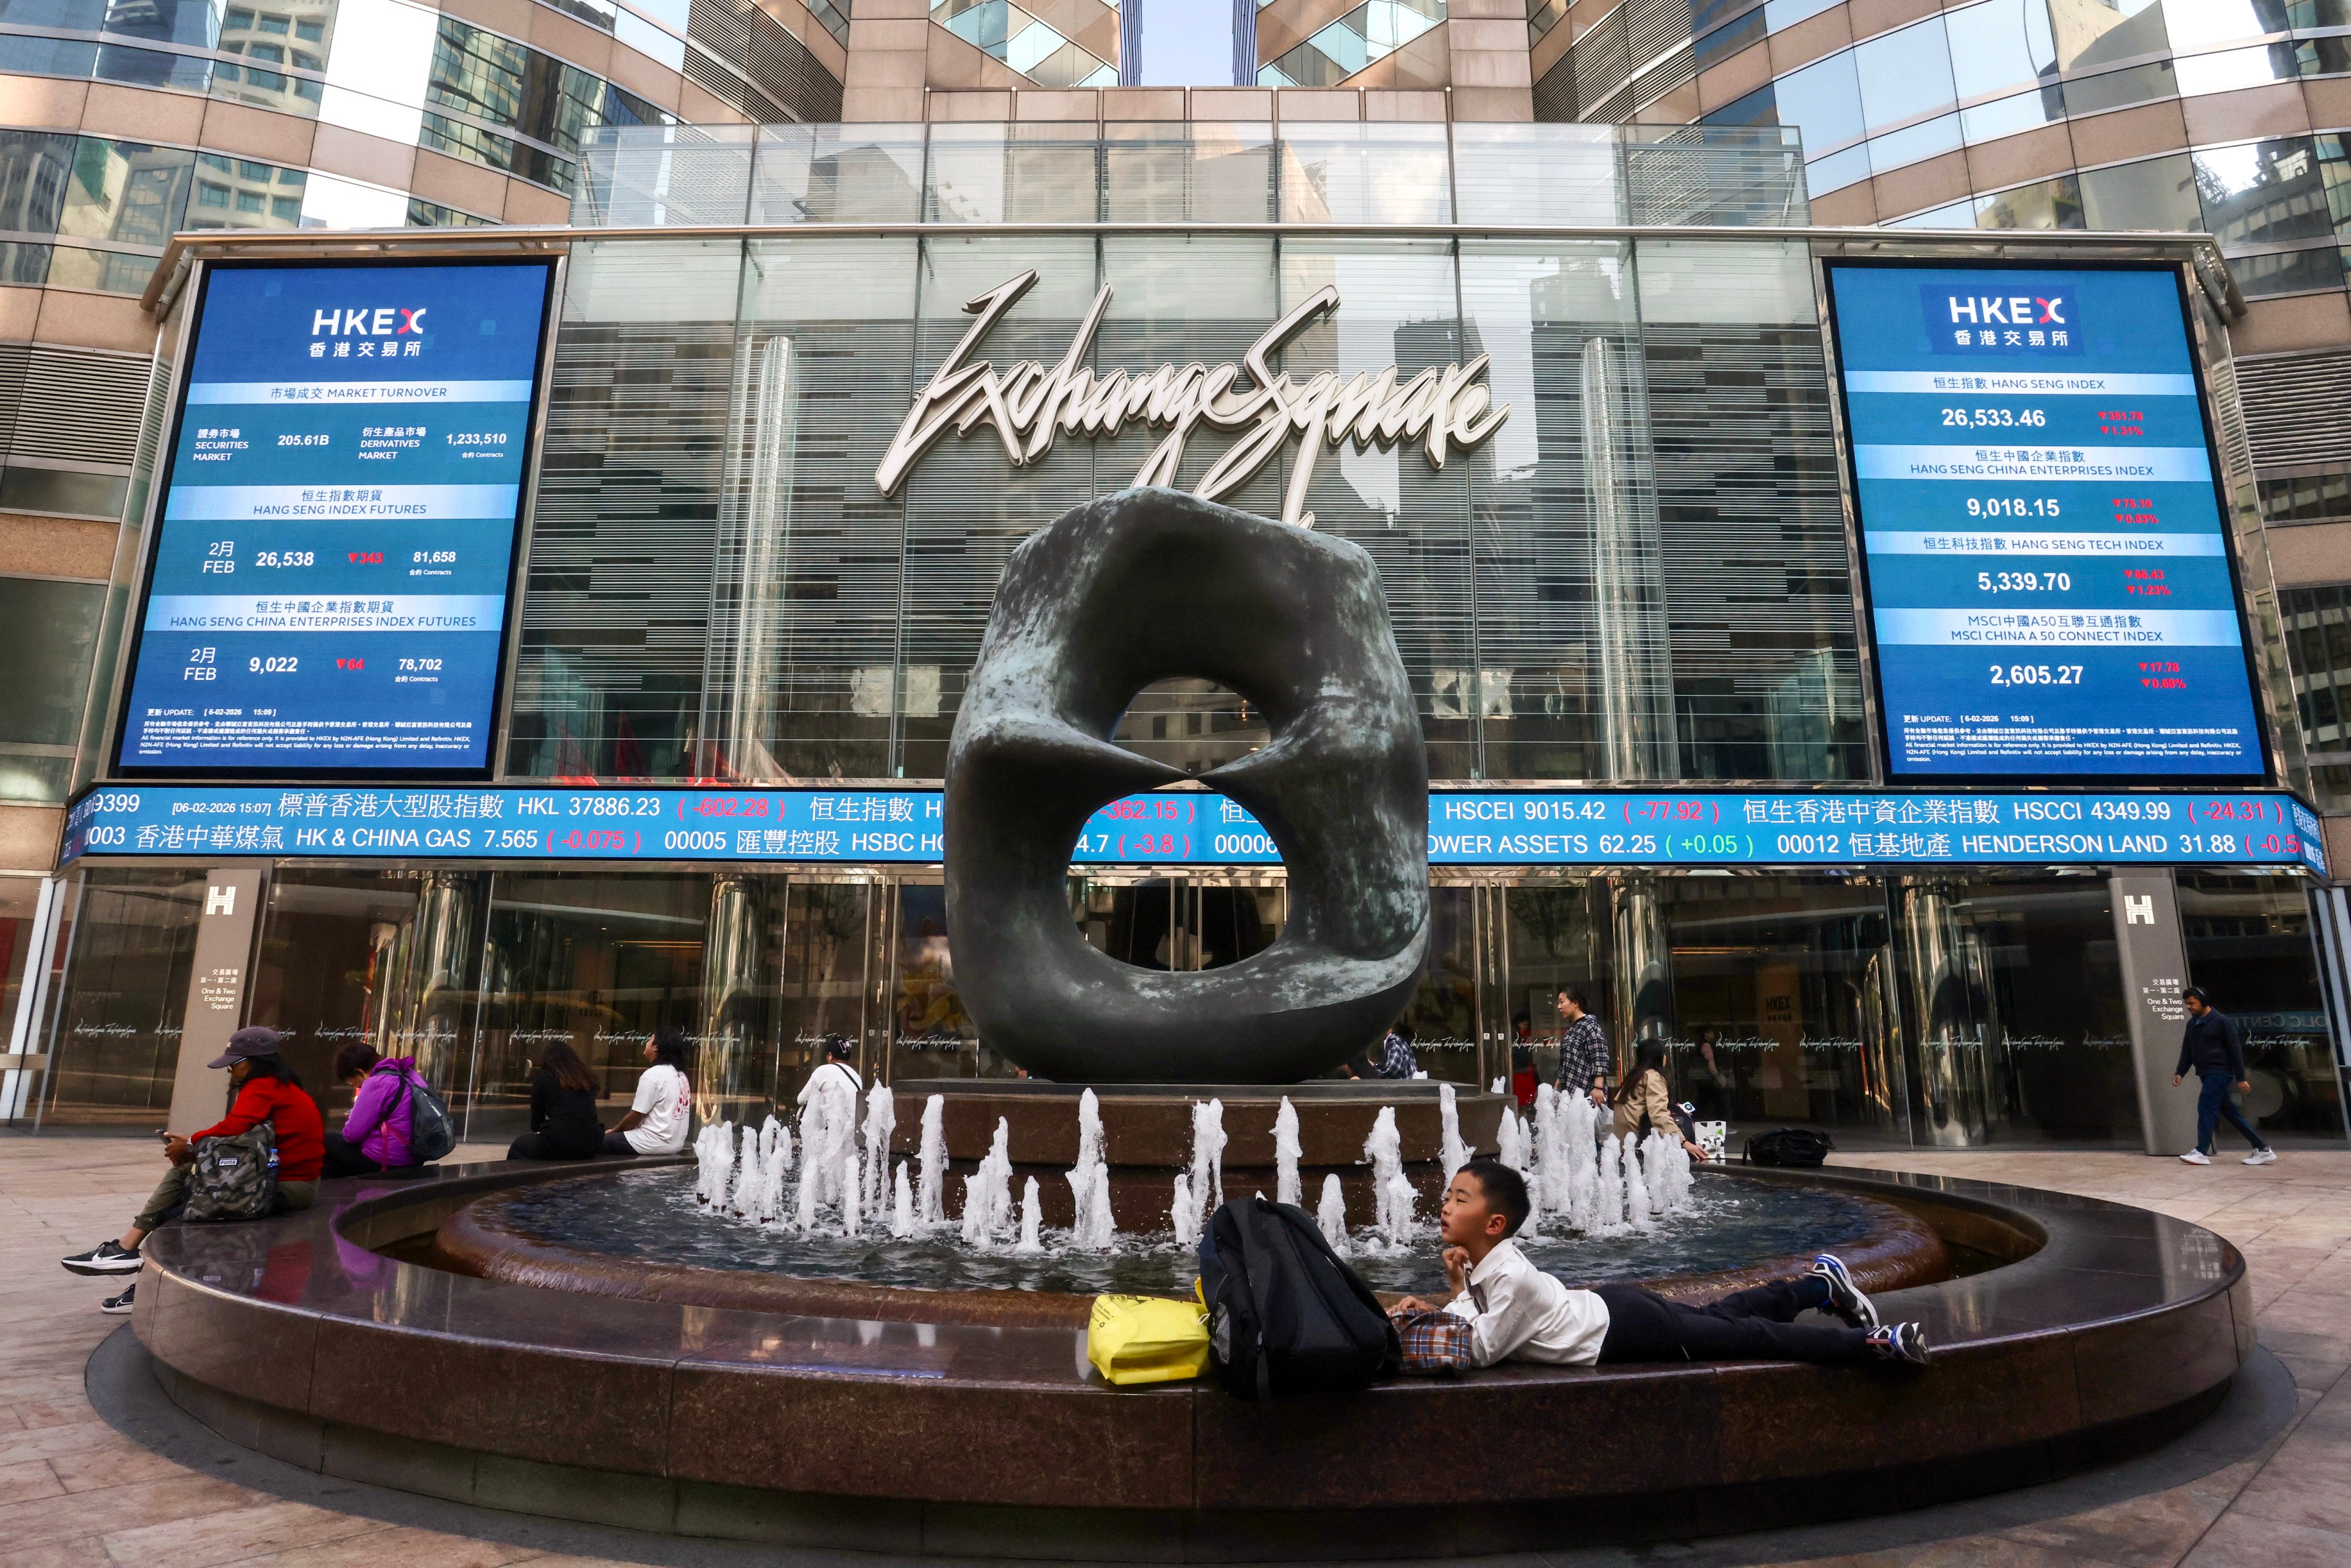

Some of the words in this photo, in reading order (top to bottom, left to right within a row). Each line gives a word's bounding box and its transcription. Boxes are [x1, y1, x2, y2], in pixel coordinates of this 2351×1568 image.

[1949, 297, 2065, 323] HKEX
[312, 308, 426, 335] HKEX
[1954, 330, 2067, 346] 香港交易所
[310, 342, 421, 357] 香港交易所
[1934, 377, 1987, 389] 恒生指數
[1992, 380, 2027, 388] HANG
[2031, 380, 2063, 388] SENG
[2067, 380, 2105, 389] INDEX
[272, 388, 323, 399] 市場成交
[328, 389, 377, 397] MARKET
[381, 388, 447, 397] TURNOVER
[874, 268, 1250, 498] Exchange
[1192, 284, 1512, 530] Square
[1942, 409, 2045, 428] 26,533.46
[363, 427, 426, 437] 衍生產品市場
[447, 433, 506, 446] 1,233,510
[278, 435, 329, 445] 205.61B
[1976, 450, 2085, 462] 恒生中國企業指數
[1911, 464, 1947, 473] HANG
[1950, 465, 1984, 474] SENG
[1988, 466, 2027, 474] CHINA
[2030, 466, 2112, 475] ENTERPRISES
[2116, 466, 2154, 475] INDEX
[302, 490, 382, 502] 恒生指數期貨
[254, 506, 289, 514] HANG
[293, 506, 324, 514] SENG
[329, 505, 367, 514] INDEX
[370, 505, 427, 513] FUTURES
[1967, 498, 2059, 518] 9,018.15
[209, 541, 234, 556] 2月
[1923, 537, 2007, 549] 恒生科技指數
[2012, 540, 2048, 548] HANG
[2052, 540, 2085, 549] SENG
[2088, 540, 2121, 549] TECH
[2125, 541, 2164, 549] INDEX
[255, 552, 314, 568] 26,538
[360, 552, 383, 564] 343
[413, 552, 456, 564] 81,658
[203, 561, 234, 573] FEB
[1978, 572, 2070, 593] 5,339.70
[256, 601, 394, 613] 恒生中國企業指數期貨
[170, 617, 206, 626] HANG
[210, 617, 243, 626] SENG
[247, 617, 285, 626] CHINA
[290, 617, 372, 626] ENTERPRISES
[377, 617, 415, 626] INDEX
[419, 617, 476, 626] FUTURES
[1969, 615, 2142, 628] MSCI中國A50互聯互通指數
[1951, 631, 1981, 640] MSCI
[1985, 631, 2025, 640] CHINA
[2029, 632, 2037, 640] A
[2041, 632, 2055, 640] 50
[2059, 632, 2120, 641] CONNECT
[2124, 632, 2163, 641] INDEX
[191, 648, 215, 663] 2月
[250, 657, 297, 674] 9,022
[348, 659, 364, 670] 64
[400, 659, 442, 672] 78,702
[184, 668, 216, 680] FEB
[1990, 665, 2083, 687] 2,605.27
[172, 803, 236, 815] [06-02-2026
[240, 803, 271, 816] 15:07]
[278, 793, 504, 818] 標普香港大型股指數
[518, 797, 559, 814] HKL
[569, 797, 660, 816] 37886.23
[810, 797, 914, 822] 恒生指數
[1446, 802, 1513, 820] HSCEI
[1524, 802, 1605, 820] 9015.42
[1743, 799, 2000, 824] 恒生香港中資企業指數
[2014, 802, 2081, 820] HSCCI
[2091, 802, 2170, 820] 4349.99
[135, 824, 283, 850] 香港中華煤氣
[297, 828, 327, 845] HK
[332, 828, 345, 846] &
[353, 828, 419, 846] CHINA
[426, 829, 471, 847] GAS
[485, 830, 537, 848] 7.565
[665, 831, 726, 850] 00005
[737, 830, 840, 855] 匯豐控股
[853, 833, 914, 851] HSBC
[1074, 834, 1108, 852] 4.7
[1215, 835, 1277, 853] 00006
[1427, 835, 1492, 854] OWER
[1498, 835, 1588, 853] ASSETS
[1600, 835, 1656, 853] 62.25
[1778, 835, 1839, 853] 00012
[1849, 833, 1952, 857] 恒基地產
[1962, 835, 2103, 853] HENDERSON
[2109, 835, 2167, 852] LAND
[2180, 835, 2236, 853] 31.88
